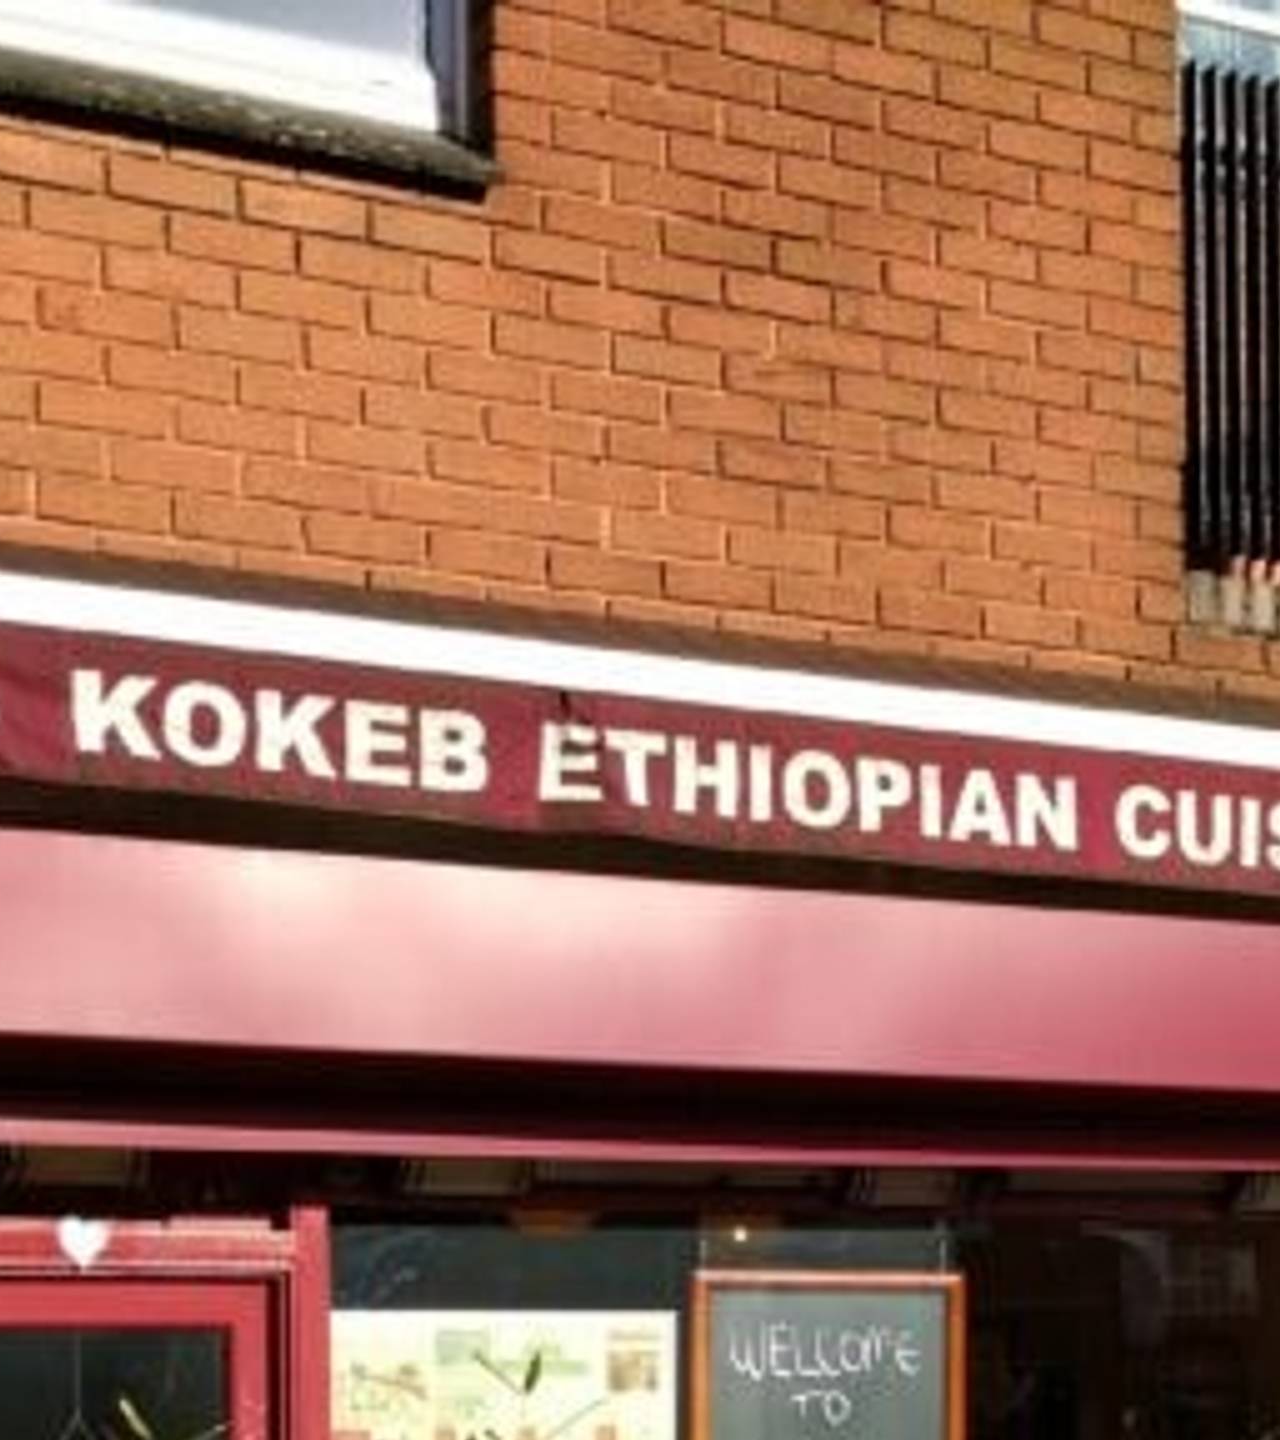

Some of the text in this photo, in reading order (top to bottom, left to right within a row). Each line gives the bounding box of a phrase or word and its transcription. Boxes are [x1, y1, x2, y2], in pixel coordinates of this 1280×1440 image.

[70, 669, 489, 793] KOKEB
[537, 721, 1079, 850] ETHIOPIAN
[792, 1389, 852, 1426] TO
